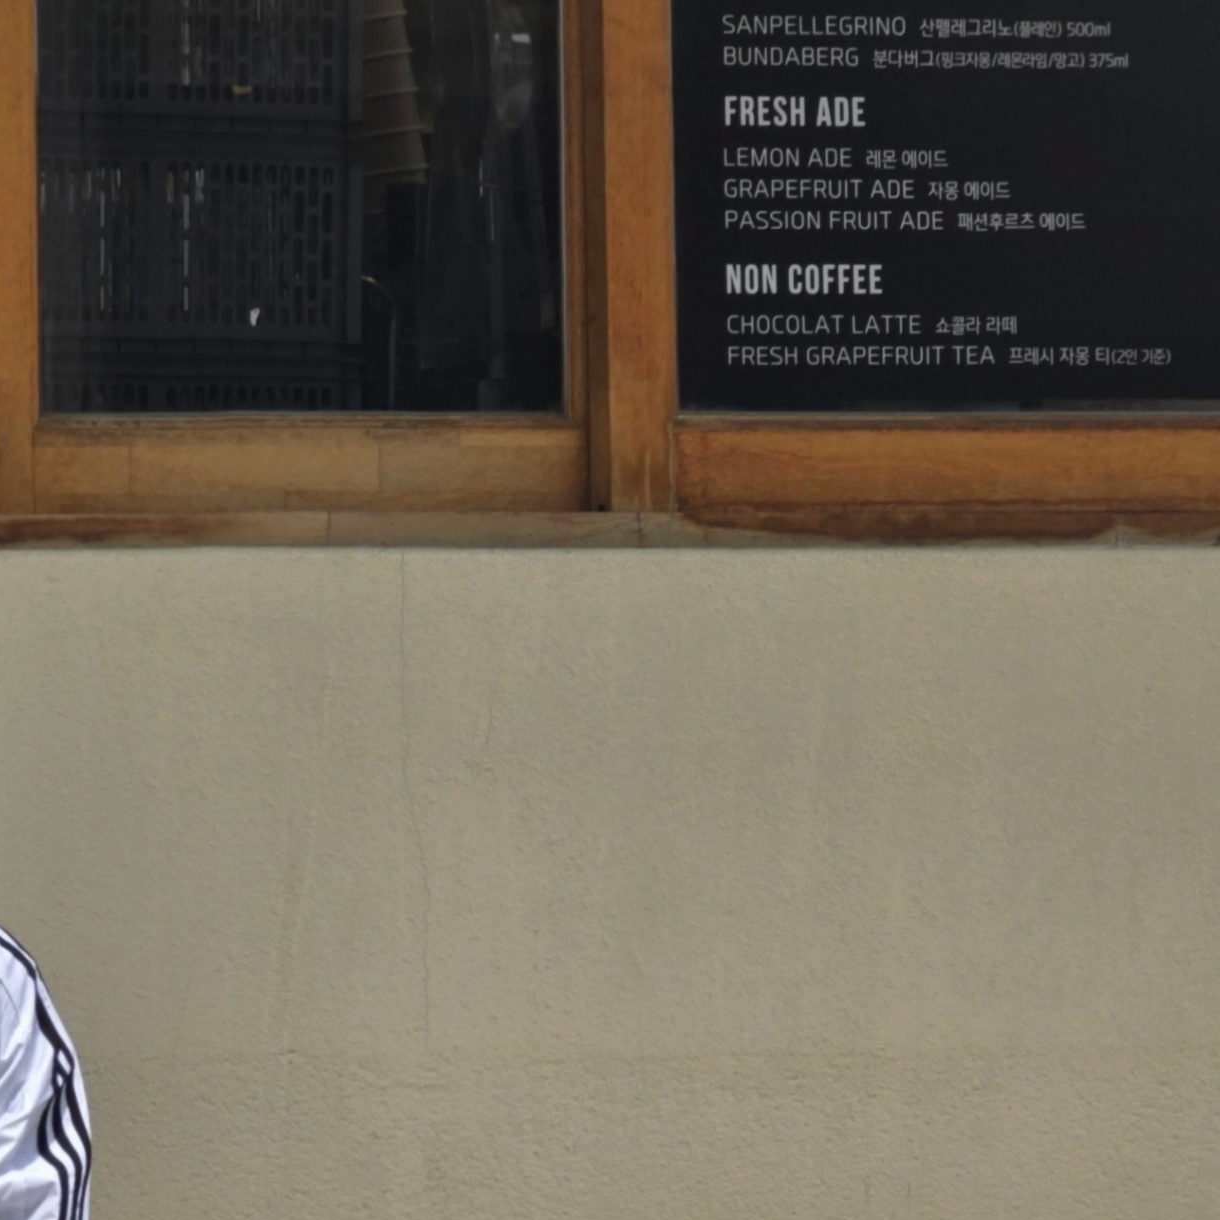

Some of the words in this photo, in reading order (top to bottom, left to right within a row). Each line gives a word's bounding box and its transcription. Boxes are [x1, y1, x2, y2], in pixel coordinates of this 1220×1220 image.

[722, 14, 906, 36] SANPELLEGRINO
[1067, 22, 1111, 37] 500ml
[724, 46, 859, 67] BUNDABERG
[1089, 53, 1129, 68] 375ml
[724, 96, 806, 127] FRESH
[816, 97, 866, 127] ADE
[724, 147, 800, 168] LEMON
[808, 148, 852, 168] ADE
[866, 150, 897, 169] 레몬
[902, 150, 948, 169] 에이드
[724, 179, 862, 199] GRAPEFRUIT
[870, 179, 915, 199] ADE
[928, 181, 959, 201] 자몽
[964, 181, 1011, 200] 에이드
[725, 210, 821, 230] PASSION
[829, 211, 892, 230] FRUIT
[900, 211, 944, 230] ADE
[958, 212, 1035, 231] 패션후르츠
[1039, 212, 1086, 231] 에이드
[726, 264, 778, 295] NON
[788, 264, 883, 295] COFFEE
[727, 315, 844, 335] CHOCOLAT
[852, 315, 922, 335] LATTE
[936, 316, 981, 336] 쇼콜라
[986, 316, 1017, 335] 라떼
[728, 346, 798, 366] FRESH
[806, 346, 944, 366] GRAPEFRUIT
[952, 346, 996, 366] TEA
[1009, 347, 1054, 366] 프레시
[1060, 347, 1090, 366] 자몽
[1095, 347, 1137, 366] 티(2인
[1142, 348, 1171, 366] 기준)
